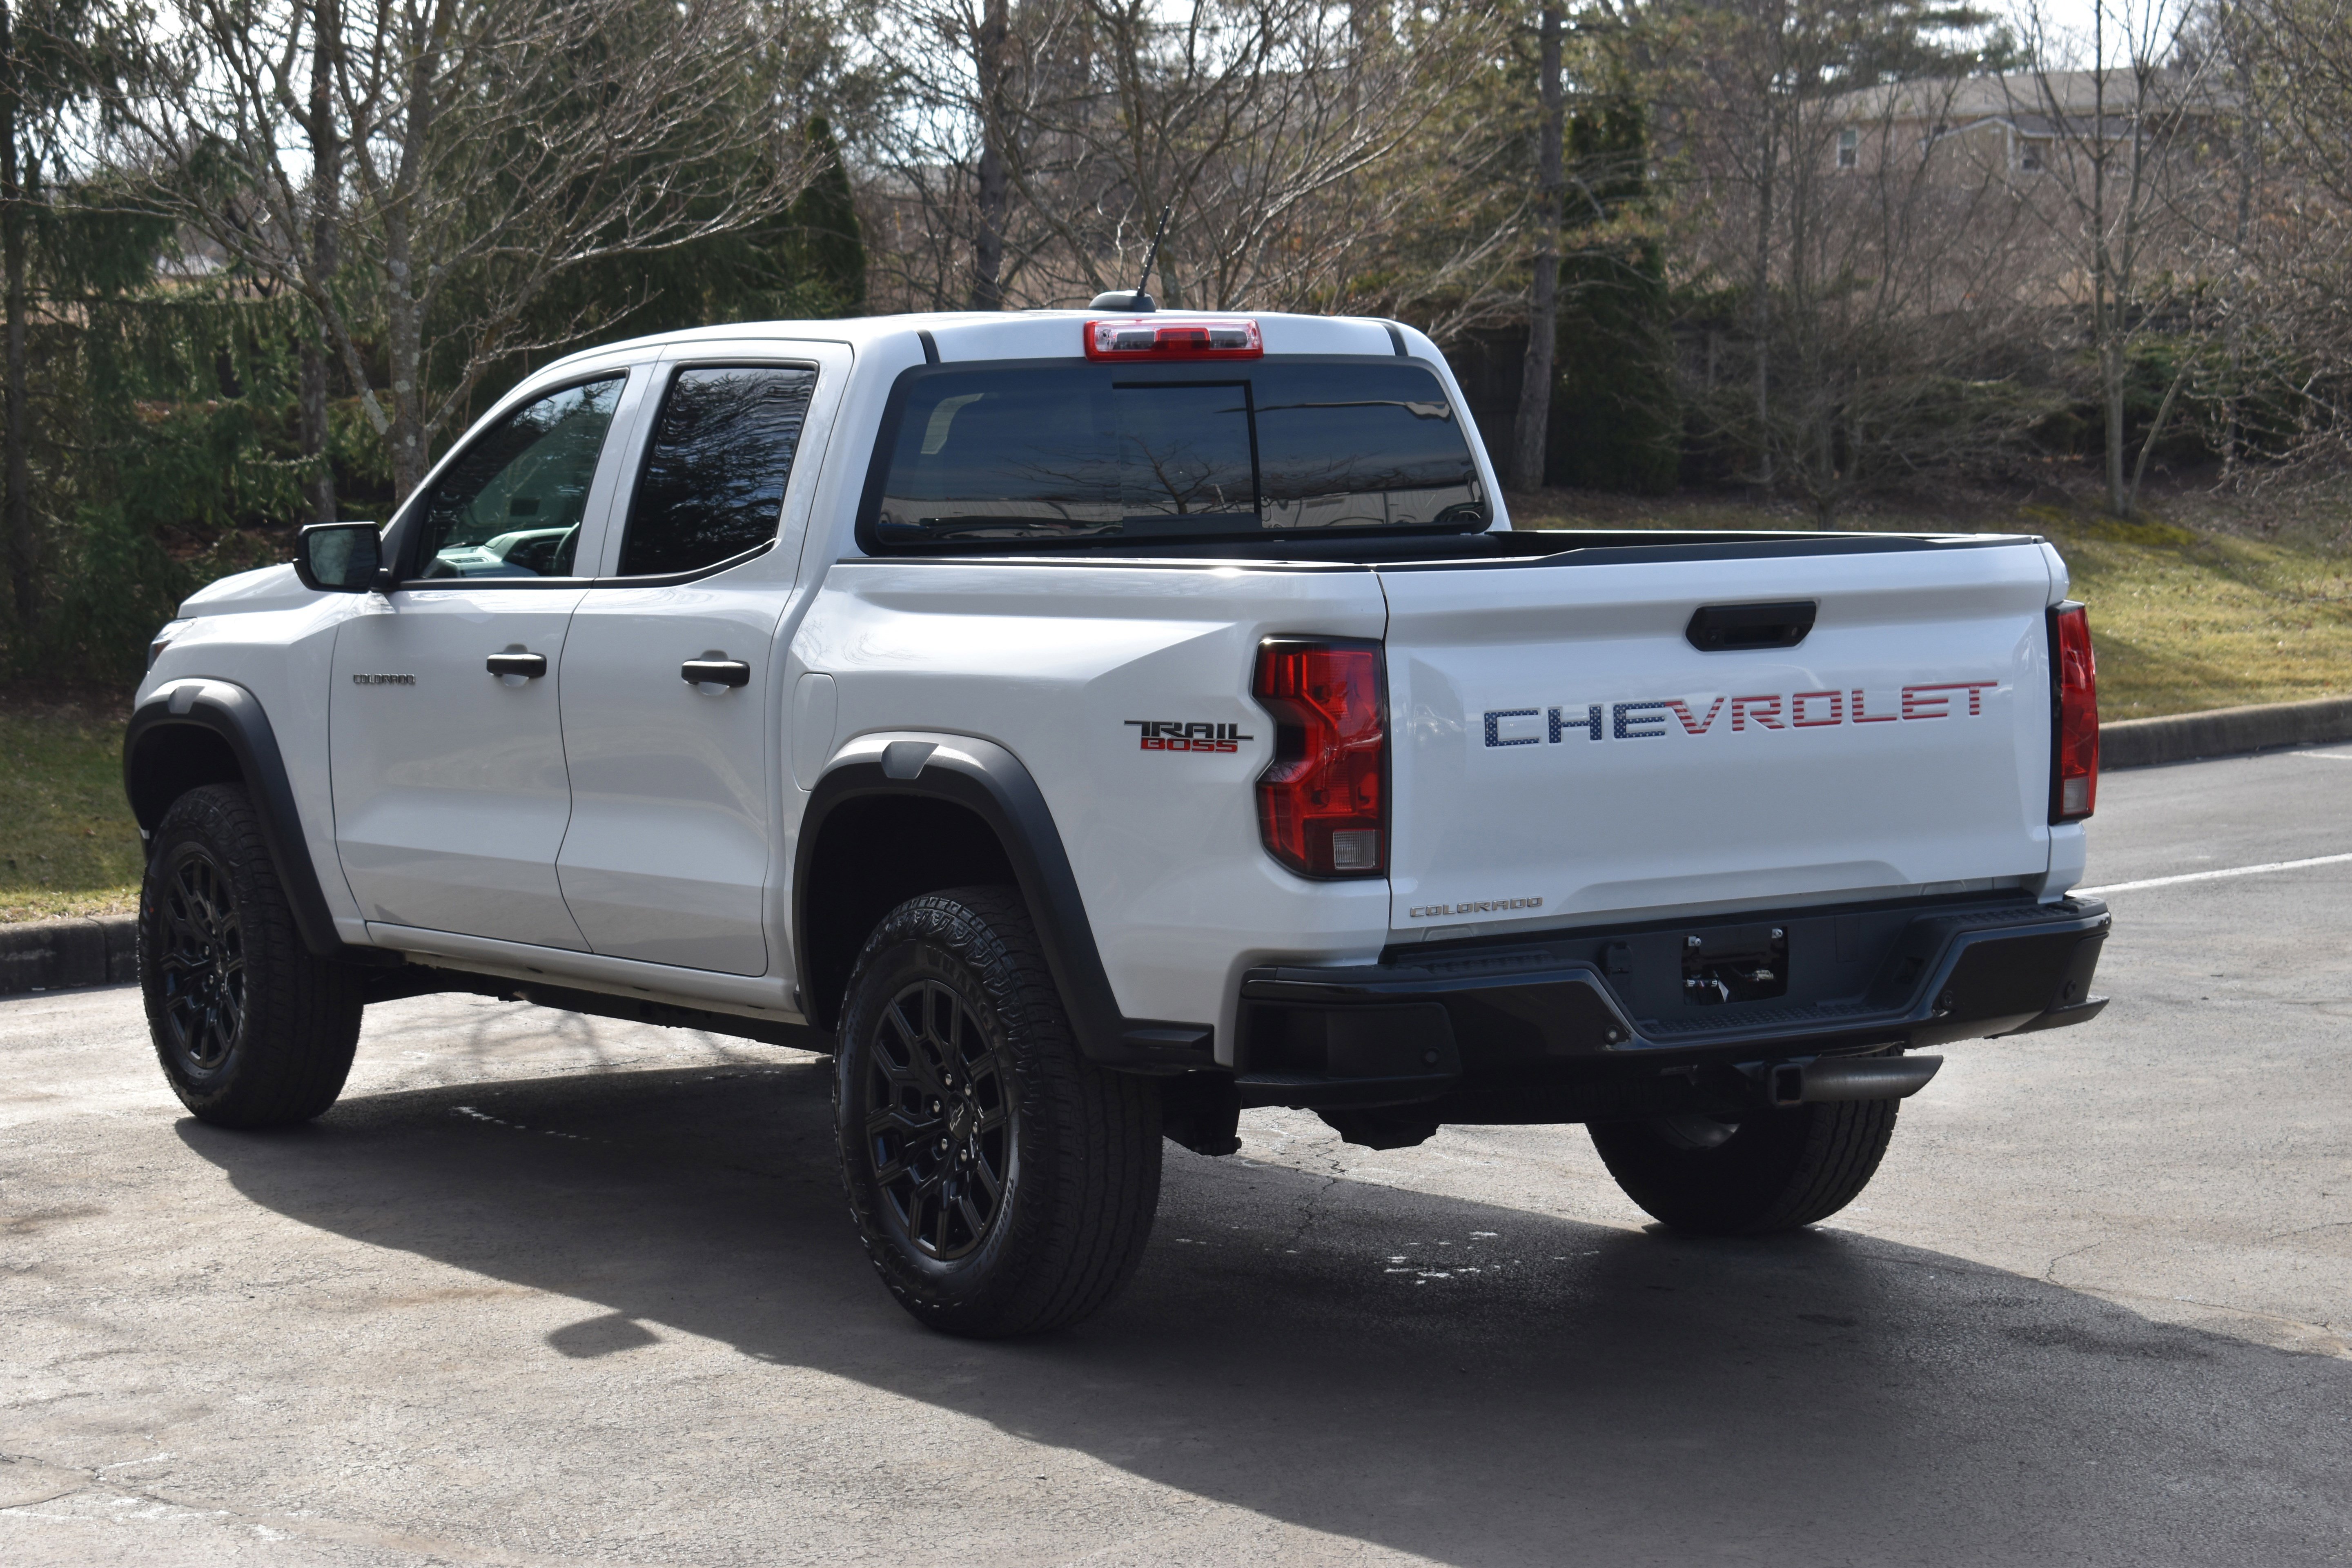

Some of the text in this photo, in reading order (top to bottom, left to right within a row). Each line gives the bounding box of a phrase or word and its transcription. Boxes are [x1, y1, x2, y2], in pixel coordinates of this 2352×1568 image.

[353, 674, 416, 684] COLORADO
[1484, 681, 1998, 747] CHEVROLET
[1124, 720, 1254, 741] TRAIL
[1140, 737, 1238, 753] BOSS
[1410, 896, 1543, 917] COLORADO
